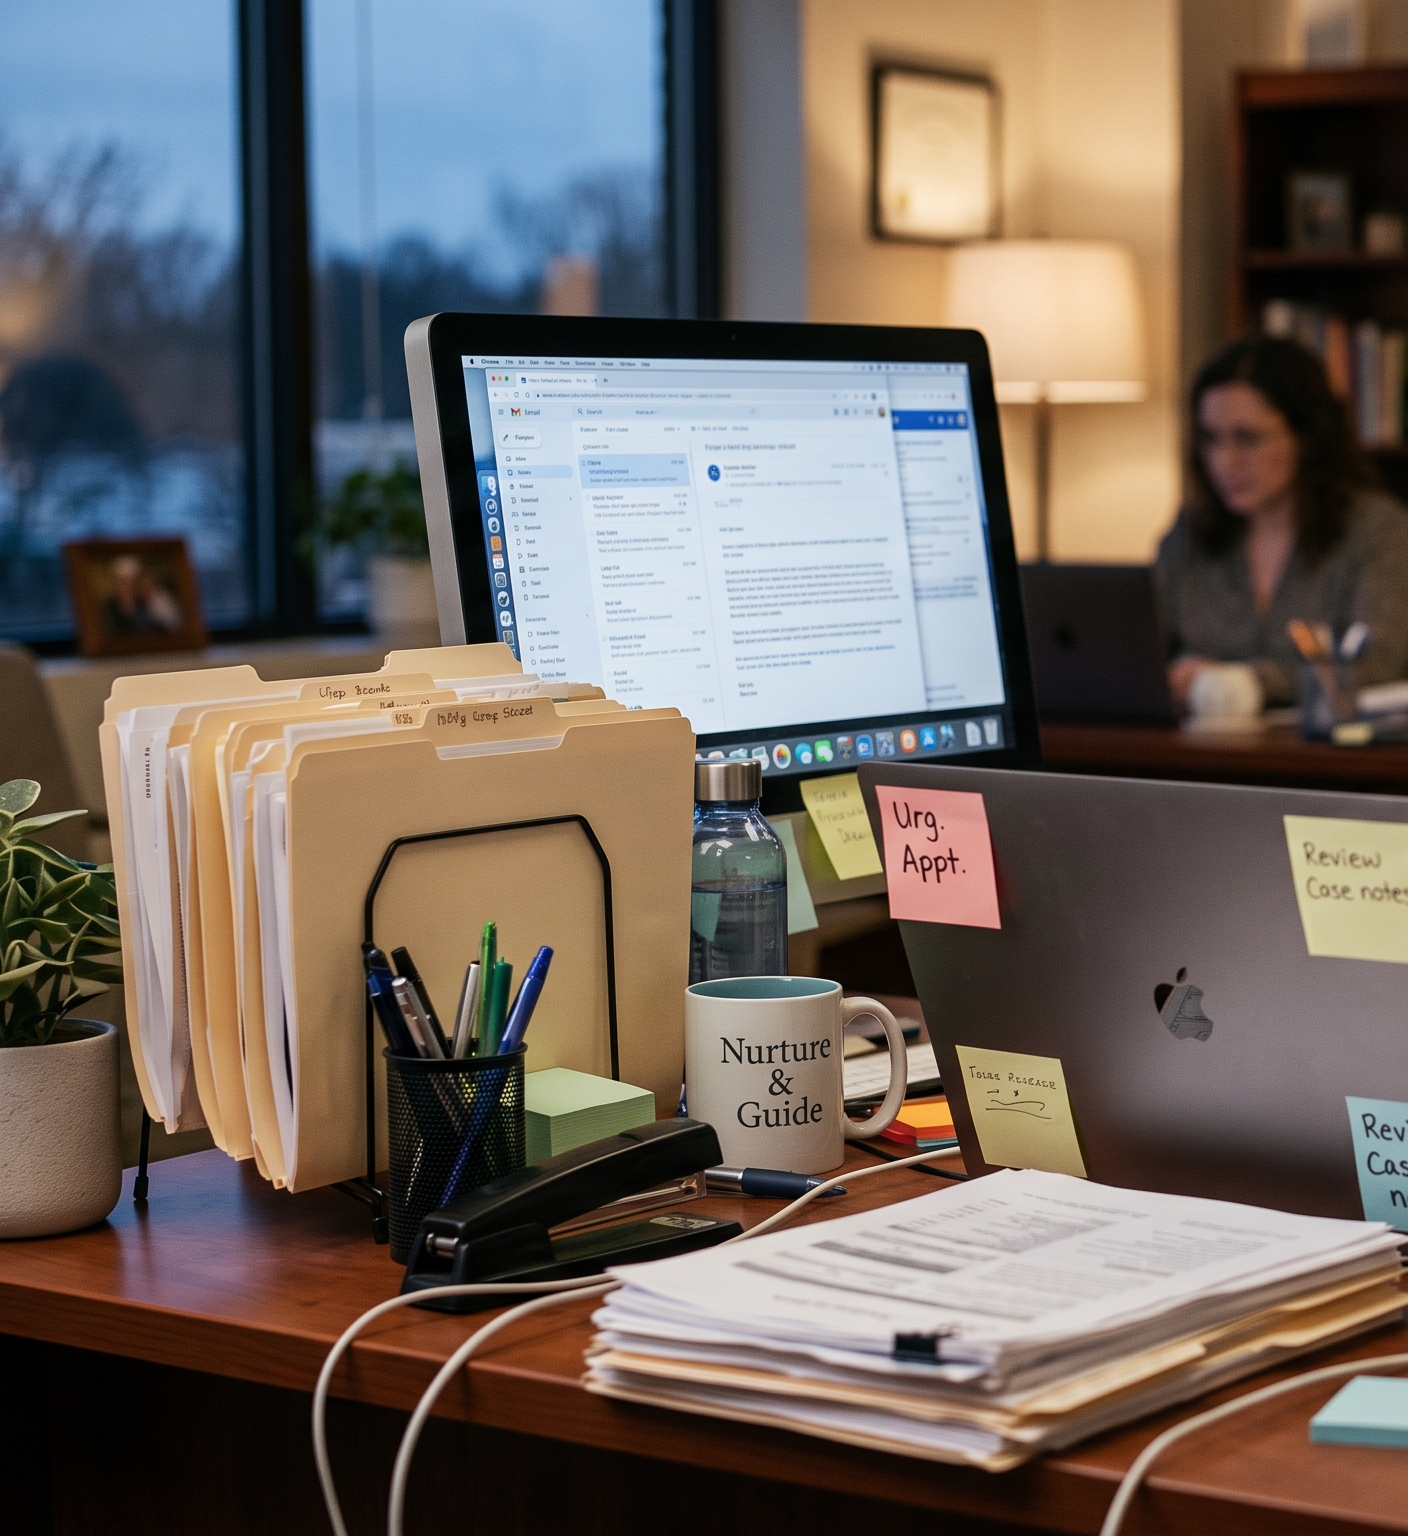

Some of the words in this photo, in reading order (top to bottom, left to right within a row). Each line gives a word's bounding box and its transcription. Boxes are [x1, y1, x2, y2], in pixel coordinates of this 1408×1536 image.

[893, 801, 945, 843] Urg.
[903, 844, 967, 884] Appt.
[1302, 841, 1382, 870] Review
[1306, 876, 1354, 902] Case
[720, 1037, 831, 1065] Nurture
[768, 1068, 794, 1096] &
[737, 1096, 823, 1128] Guide
